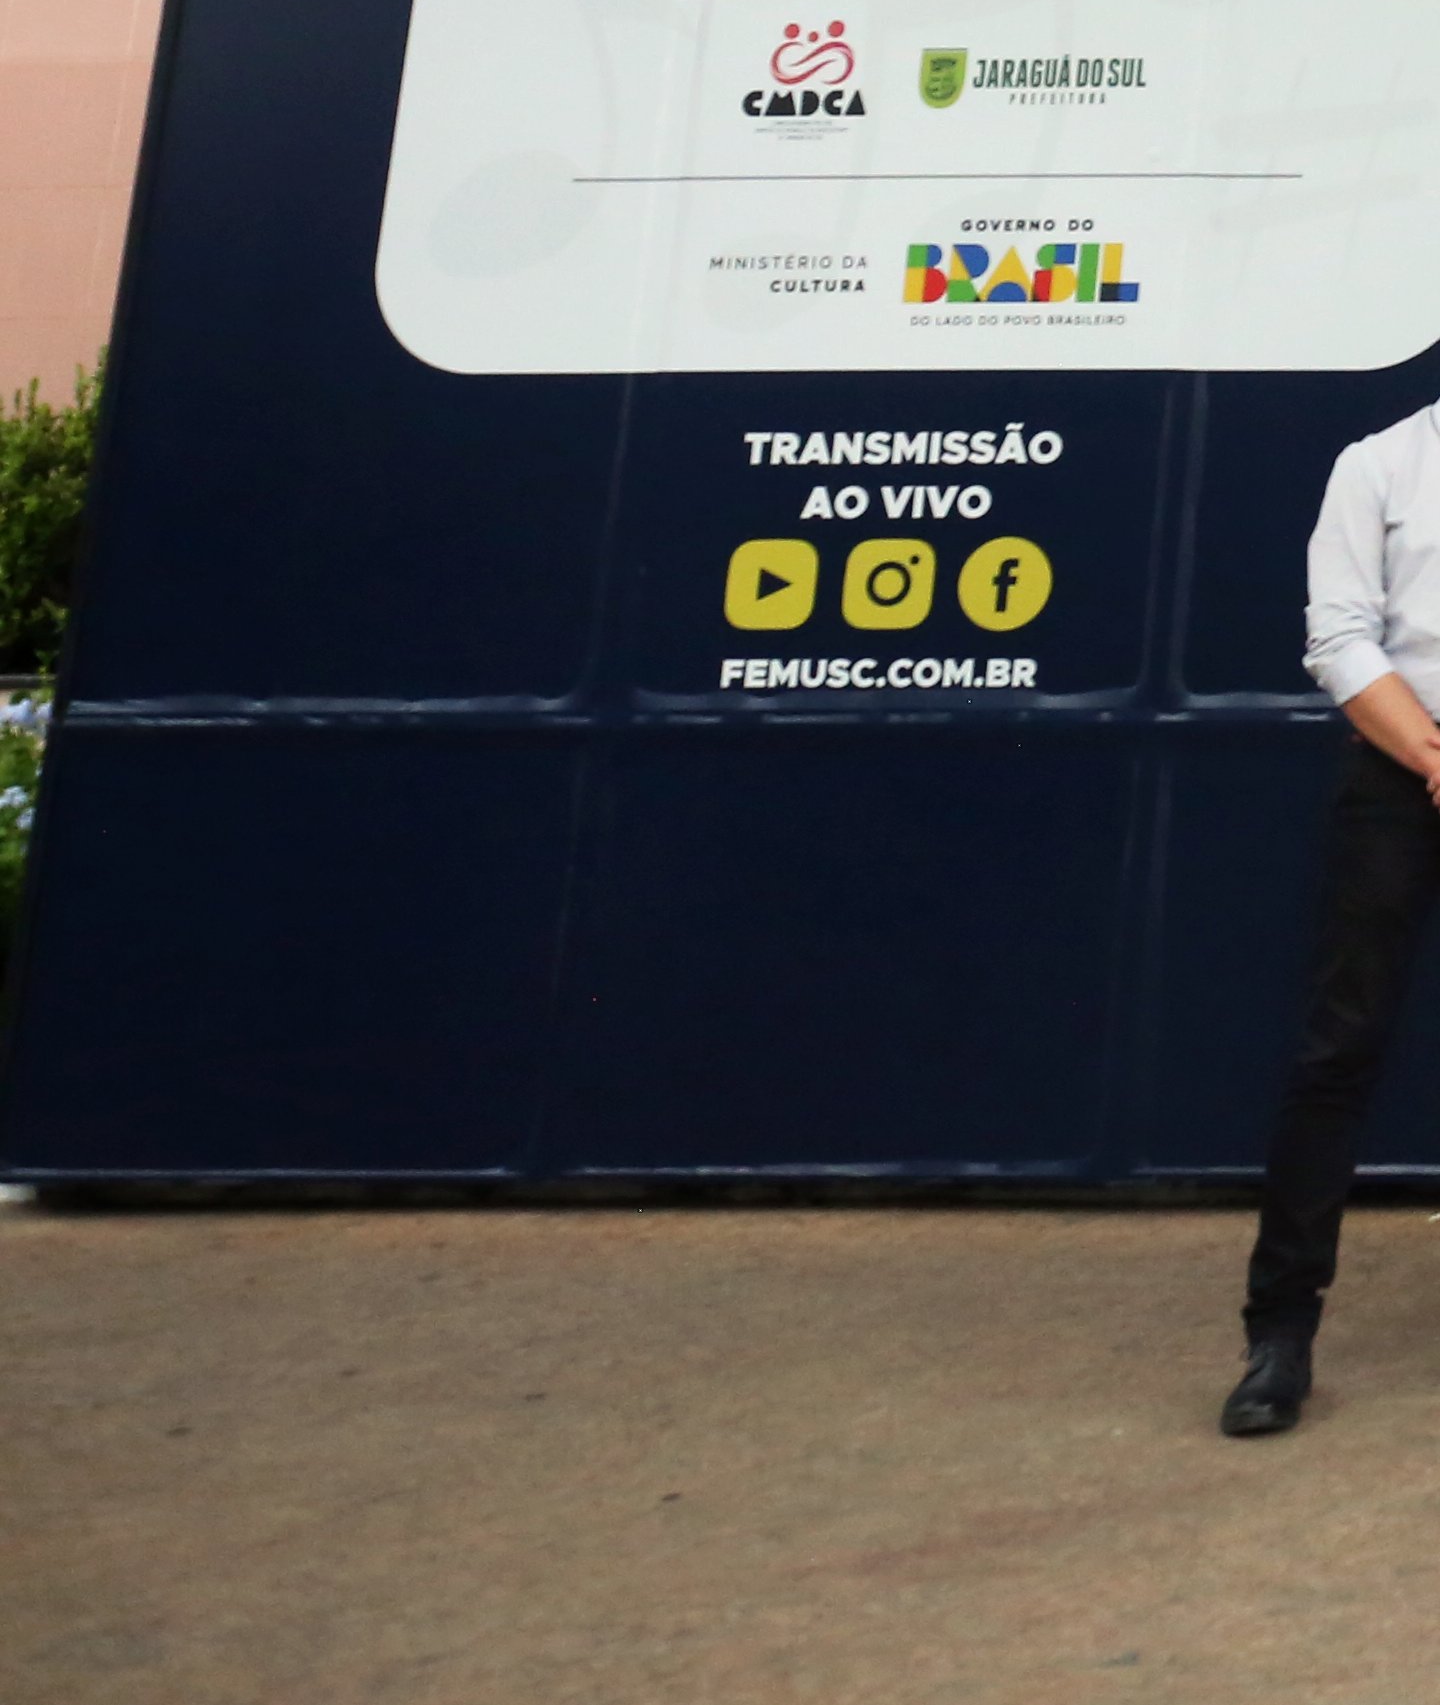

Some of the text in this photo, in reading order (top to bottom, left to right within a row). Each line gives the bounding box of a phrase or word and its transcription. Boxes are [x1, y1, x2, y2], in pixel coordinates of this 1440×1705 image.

[972, 55, 1147, 89] JARAGUÁ DO SUL
[742, 89, 867, 117] CMDCA
[960, 218, 1095, 233] GOVERNO DO
[709, 253, 869, 271] MINISTÉRIO DA
[902, 242, 1140, 303] BRASIL
[769, 279, 866, 295] CULTURA
[744, 422, 1064, 465] TRANSMISSÃO
[800, 485, 994, 520] AO VIVO
[719, 657, 1039, 690] FEMUSC.COM.BR
